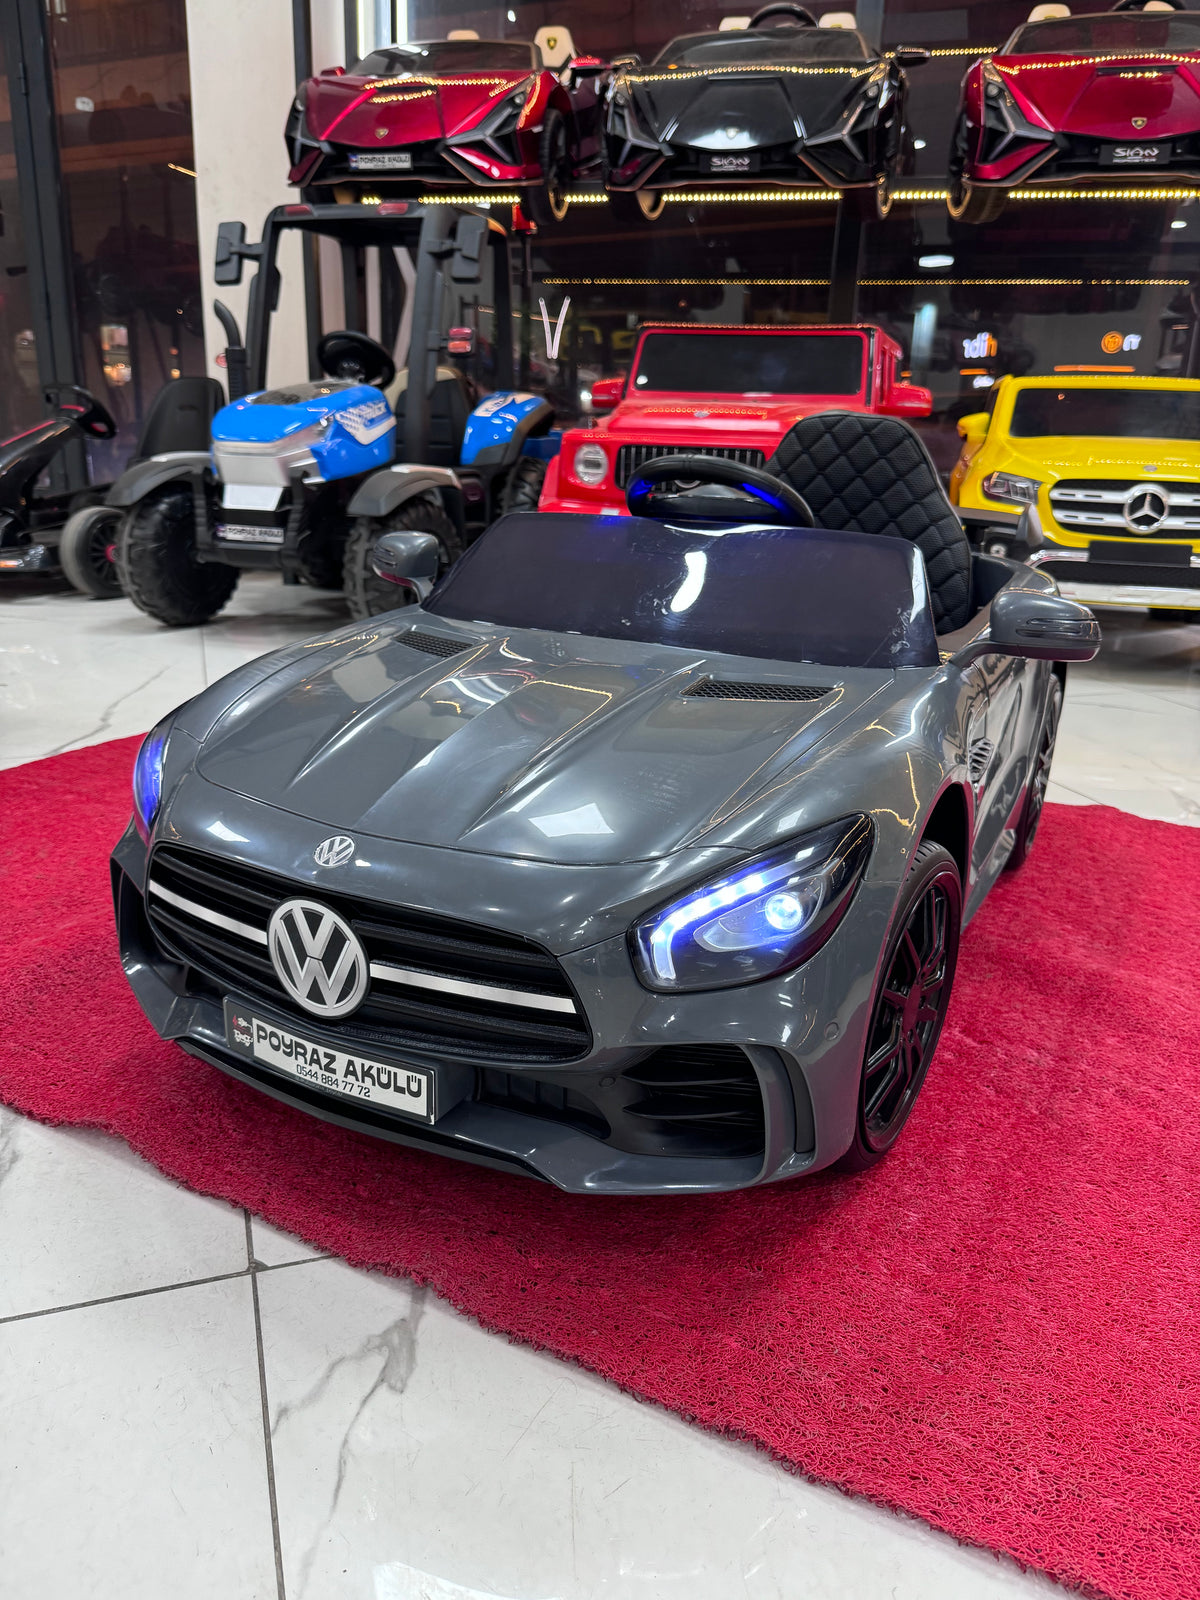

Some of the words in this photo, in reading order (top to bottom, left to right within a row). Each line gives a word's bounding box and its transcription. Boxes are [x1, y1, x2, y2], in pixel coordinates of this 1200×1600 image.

[314, 836, 355, 867] VW
[270, 900, 368, 1015] VW
[256, 1023, 337, 1075] POYRAZ
[343, 1059, 422, 1098] AKÜLÜ
[296, 1064, 319, 1081] 0544
[321, 1073, 339, 1088] 884
[342, 1080, 355, 1092] 77
[357, 1085, 371, 1098] 72
